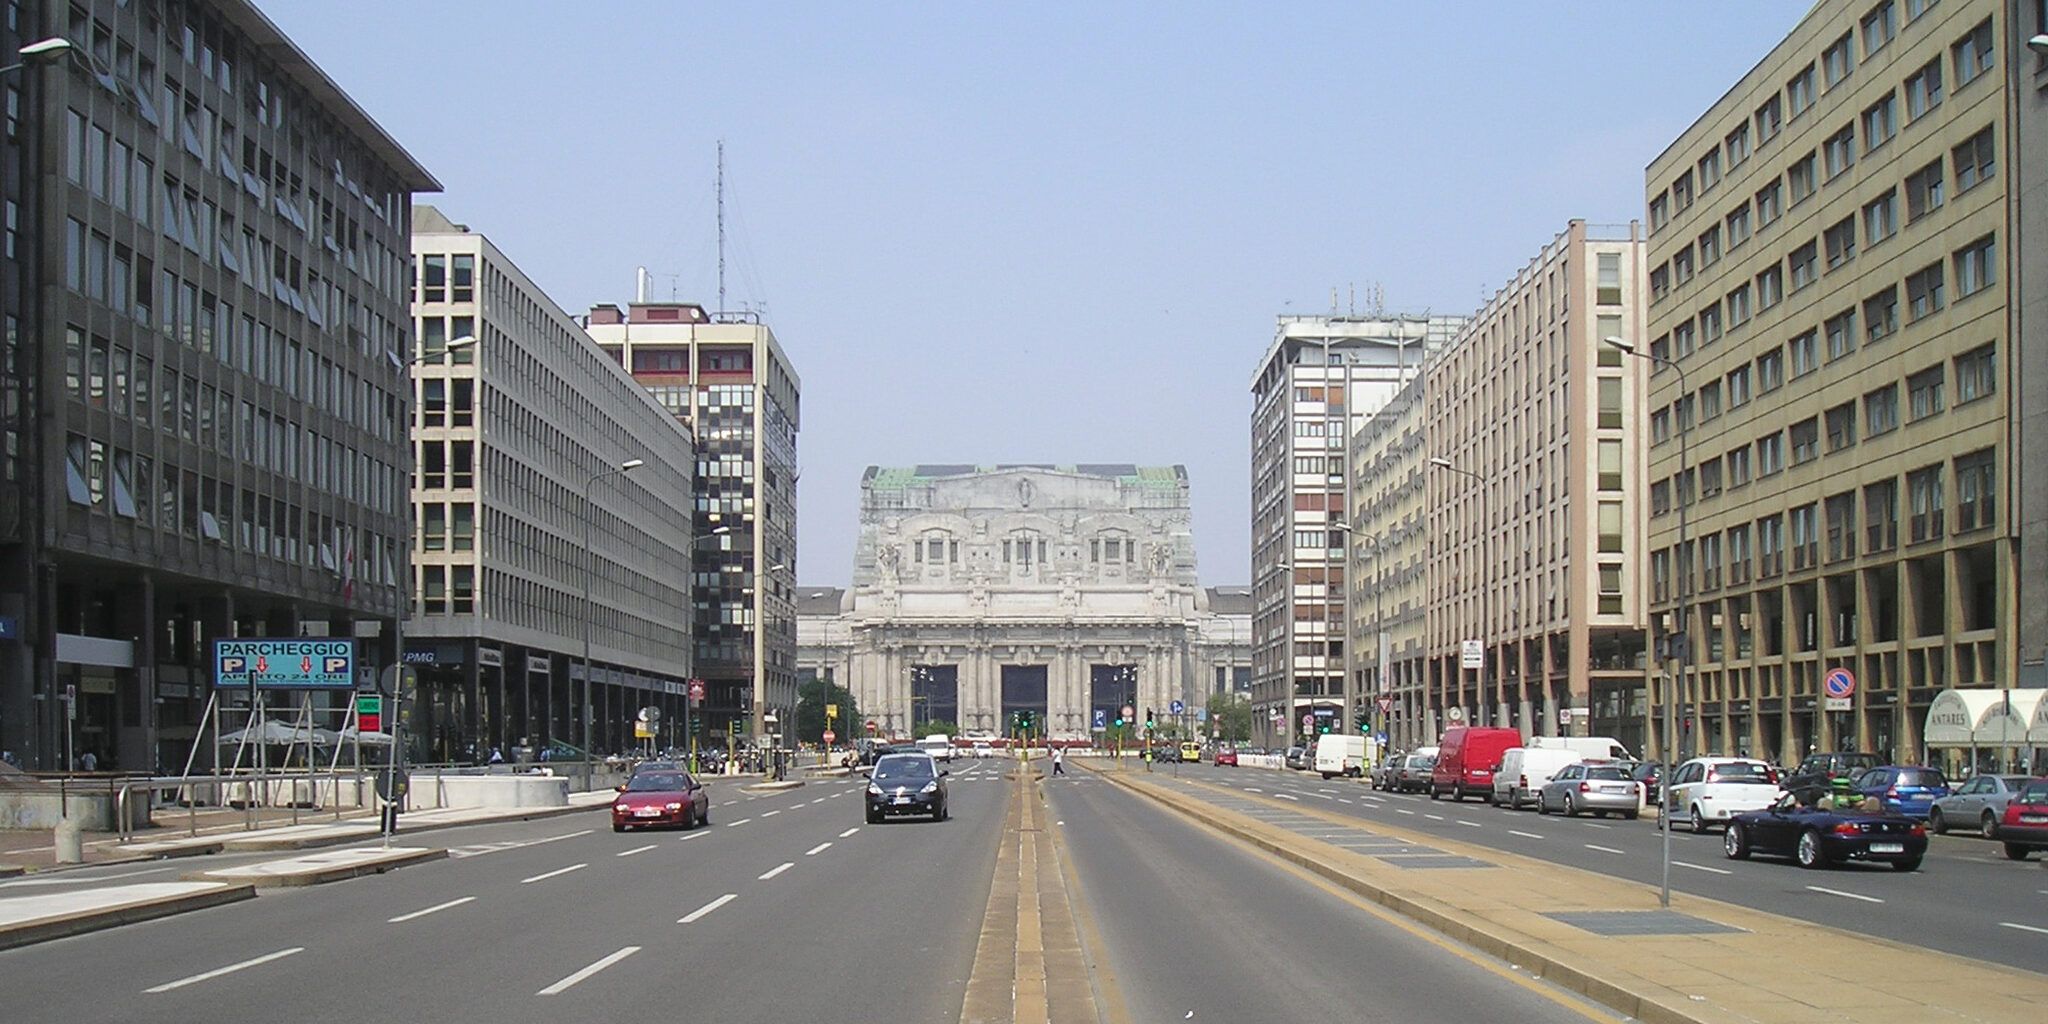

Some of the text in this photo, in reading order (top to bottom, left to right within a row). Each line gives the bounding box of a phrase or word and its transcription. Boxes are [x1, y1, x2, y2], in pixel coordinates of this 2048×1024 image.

[220, 643, 348, 656] PARCHEGGIO
[403, 652, 435, 663] PMG
[223, 658, 243, 672] P
[326, 658, 346, 672] P
[1096, 711, 1104, 720] P
[1932, 713, 1965, 725] ANTARES
